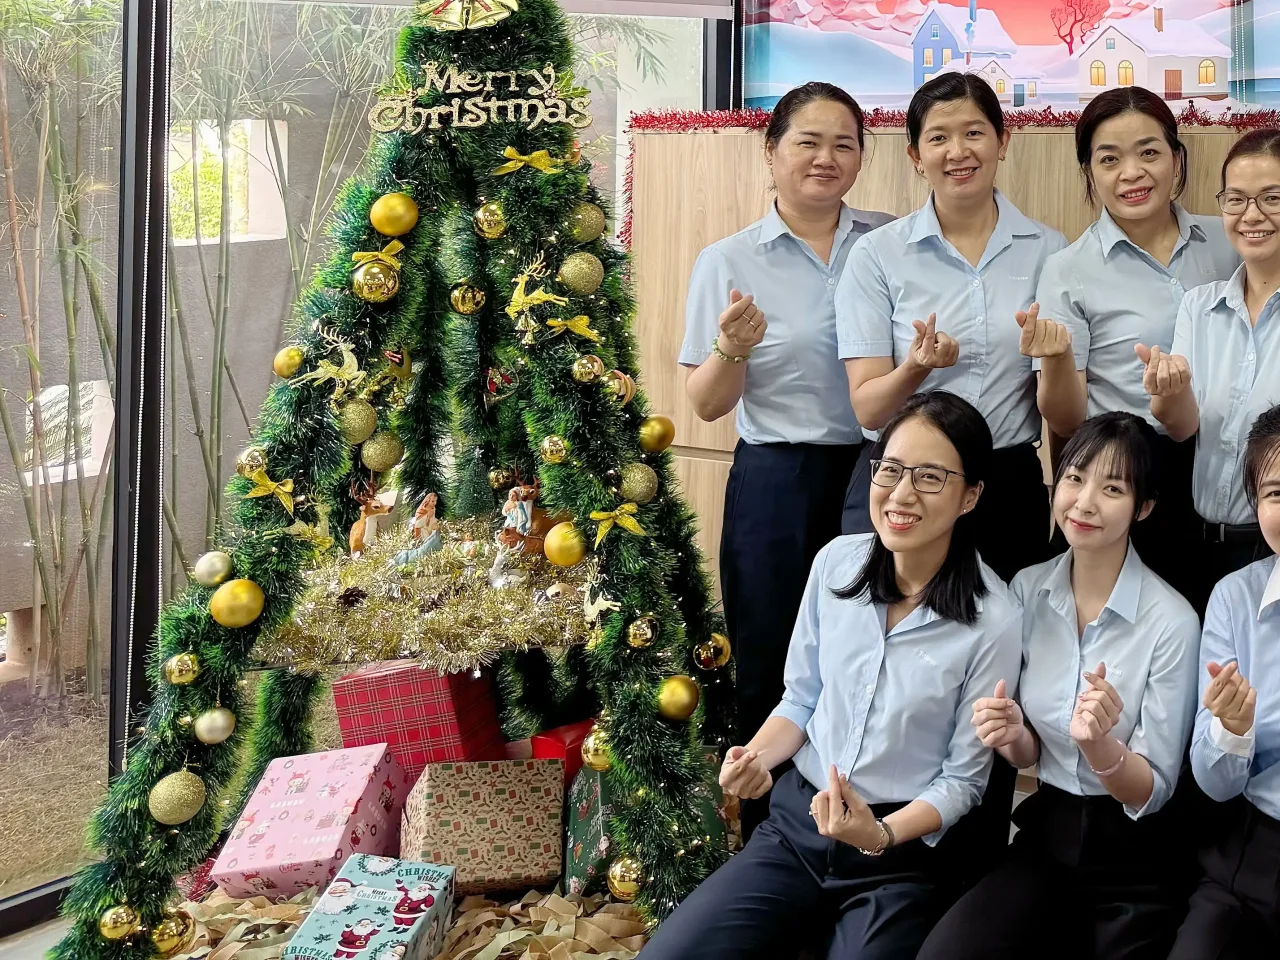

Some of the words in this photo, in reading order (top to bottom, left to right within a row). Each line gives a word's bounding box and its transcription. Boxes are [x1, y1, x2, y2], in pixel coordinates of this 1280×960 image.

[416, 62, 556, 96] Merry
[368, 94, 593, 135] Christmas
[397, 867, 450, 881] CHRISTMA
